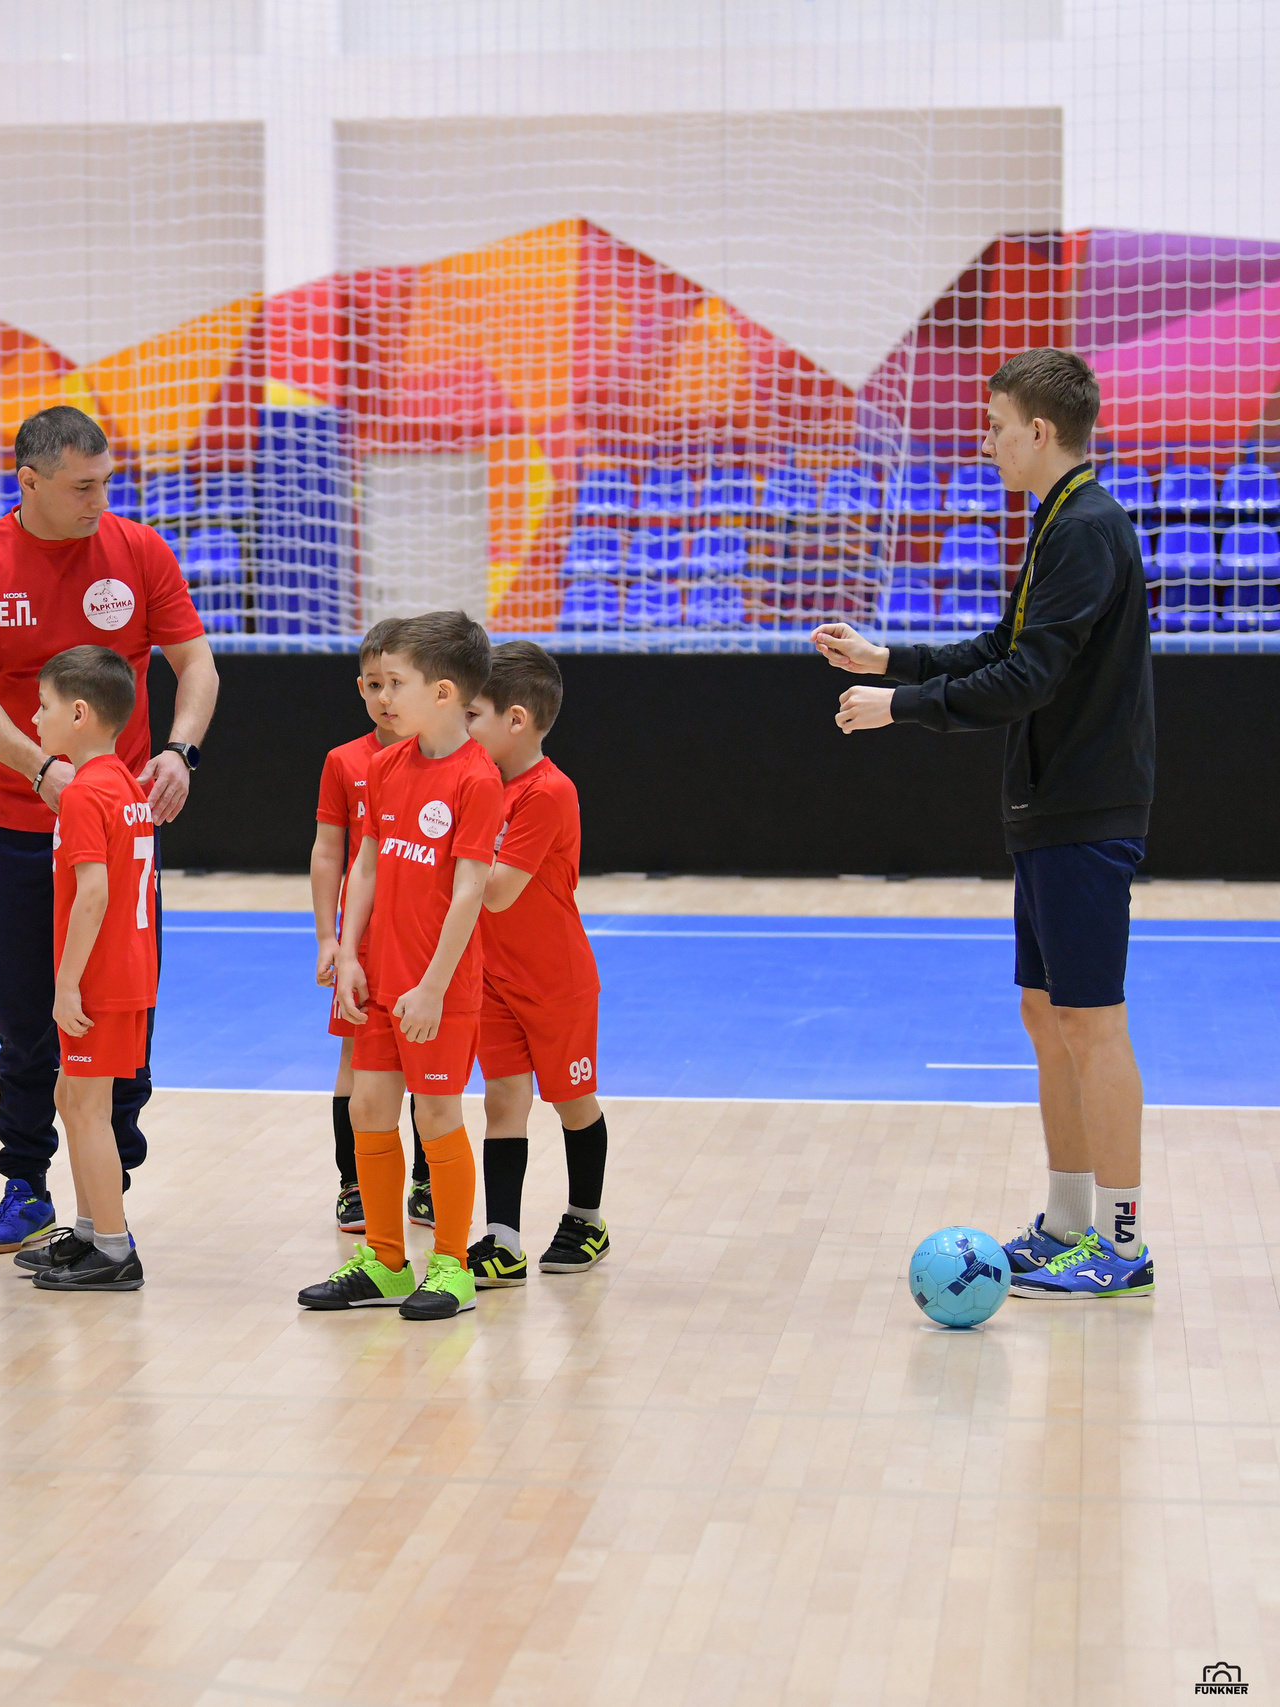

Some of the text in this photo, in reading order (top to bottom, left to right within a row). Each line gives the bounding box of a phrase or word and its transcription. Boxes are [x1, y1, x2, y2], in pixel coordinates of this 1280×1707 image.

[90, 600, 133, 612] АРКТИКА
[133, 836, 155, 929] 7
[67, 1055, 92, 1063] KODES
[424, 1073, 449, 1081] KODES
[569, 1056, 593, 1086] 99
[1114, 1201, 1136, 1244] FILA
